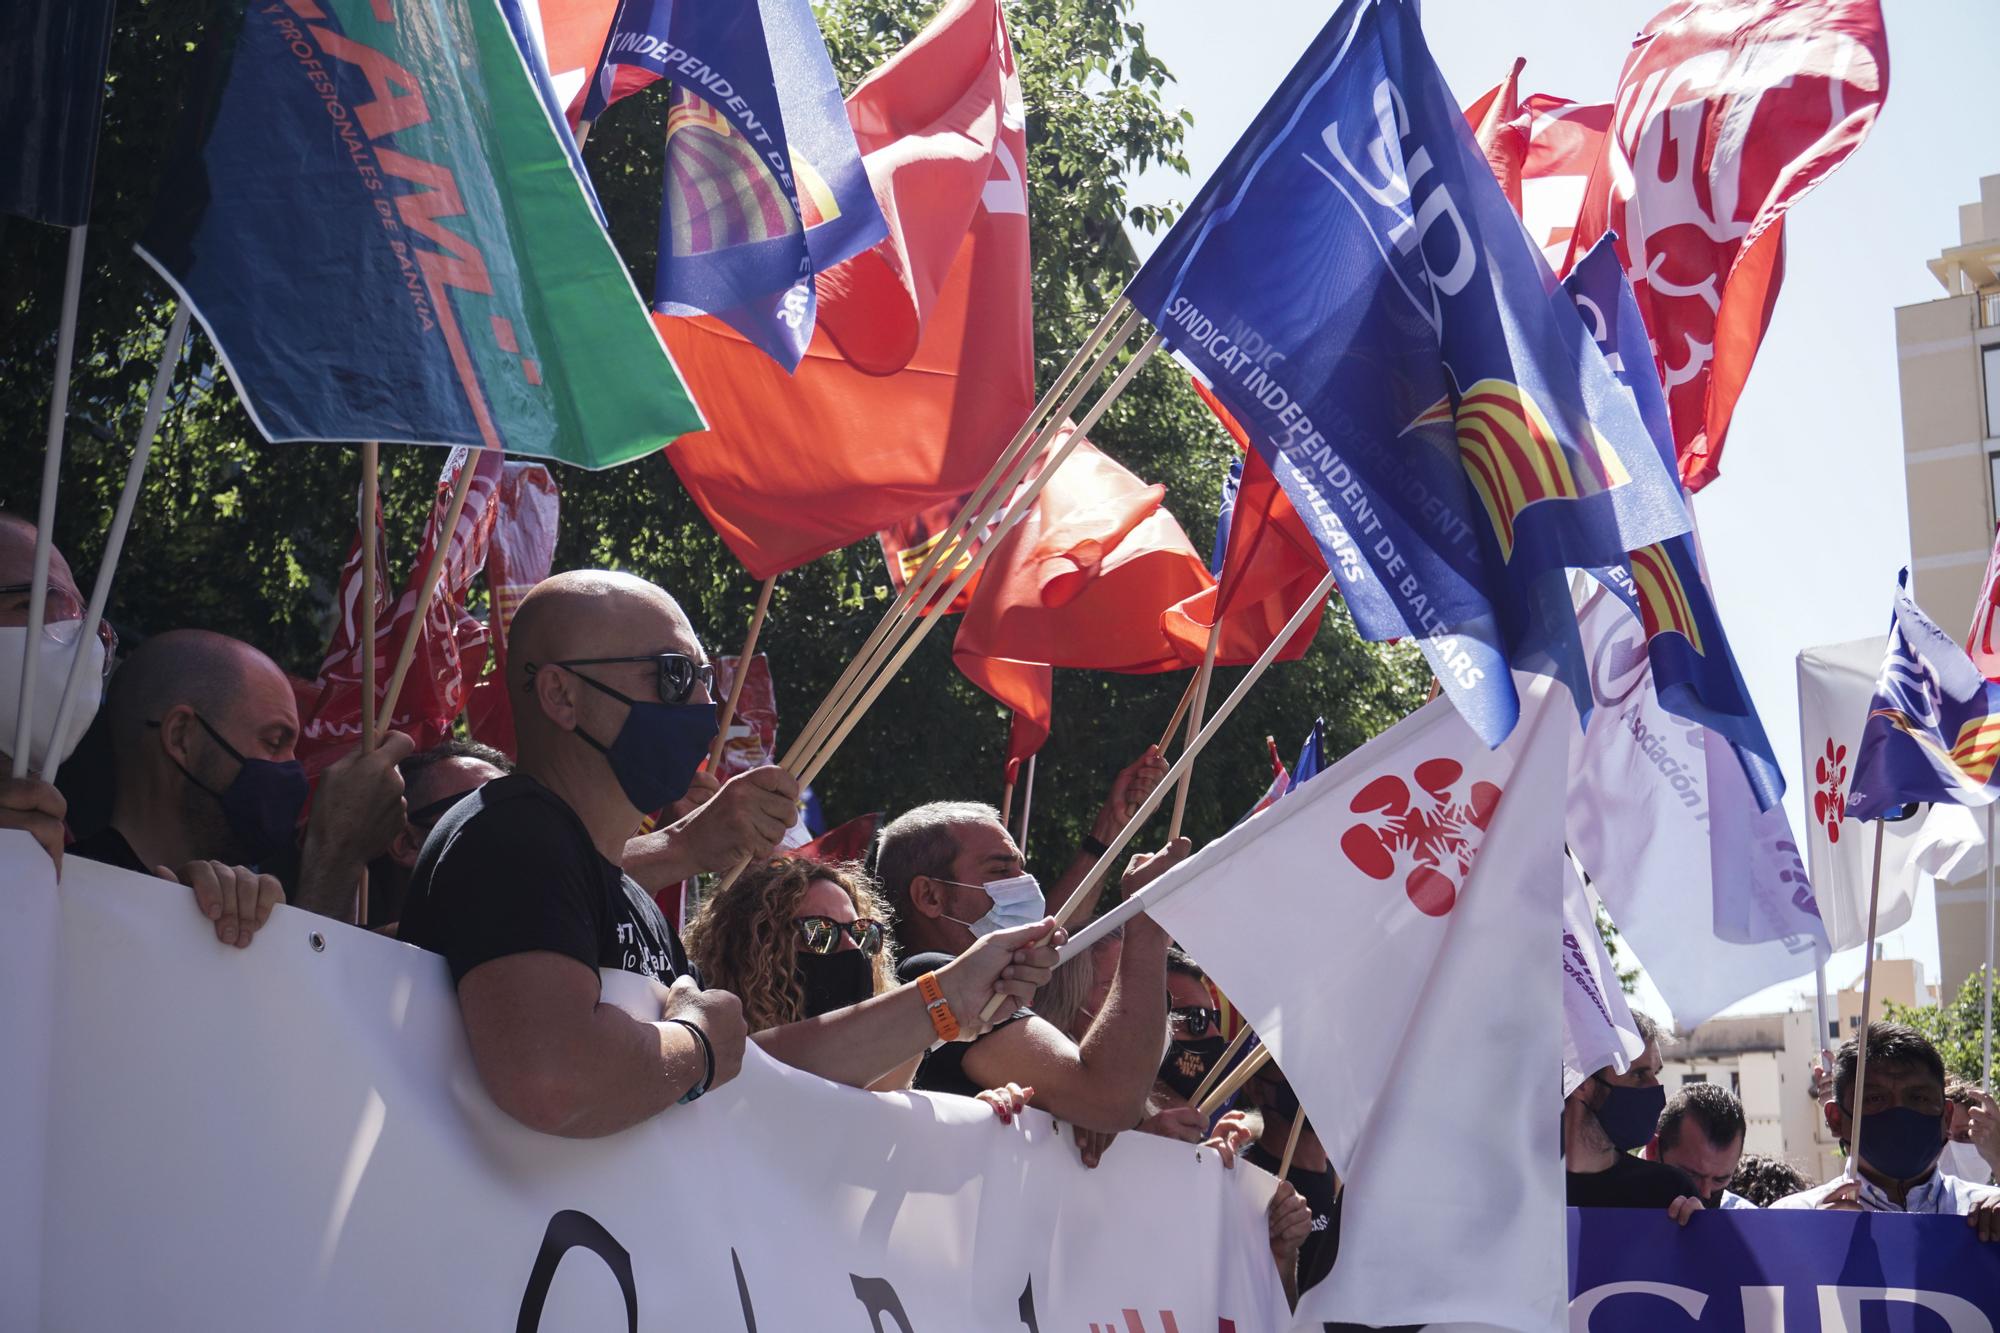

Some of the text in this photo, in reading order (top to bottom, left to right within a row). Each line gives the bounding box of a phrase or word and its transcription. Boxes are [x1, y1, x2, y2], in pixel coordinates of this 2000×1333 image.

[272, 18, 384, 191] PROFESIONALES
[373, 199, 399, 232] DE
[390, 240, 434, 332] BANKIA
[617, 32, 773, 147] INDEPENDENT
[767, 151, 793, 191] DE
[1166, 296, 1252, 375] SINDICAT
[1242, 366, 1383, 536] INDEPENDENT
[1374, 535, 1406, 577] DE
[1398, 574, 1485, 690] BALEARS
[1620, 703, 1702, 808] Asociación
